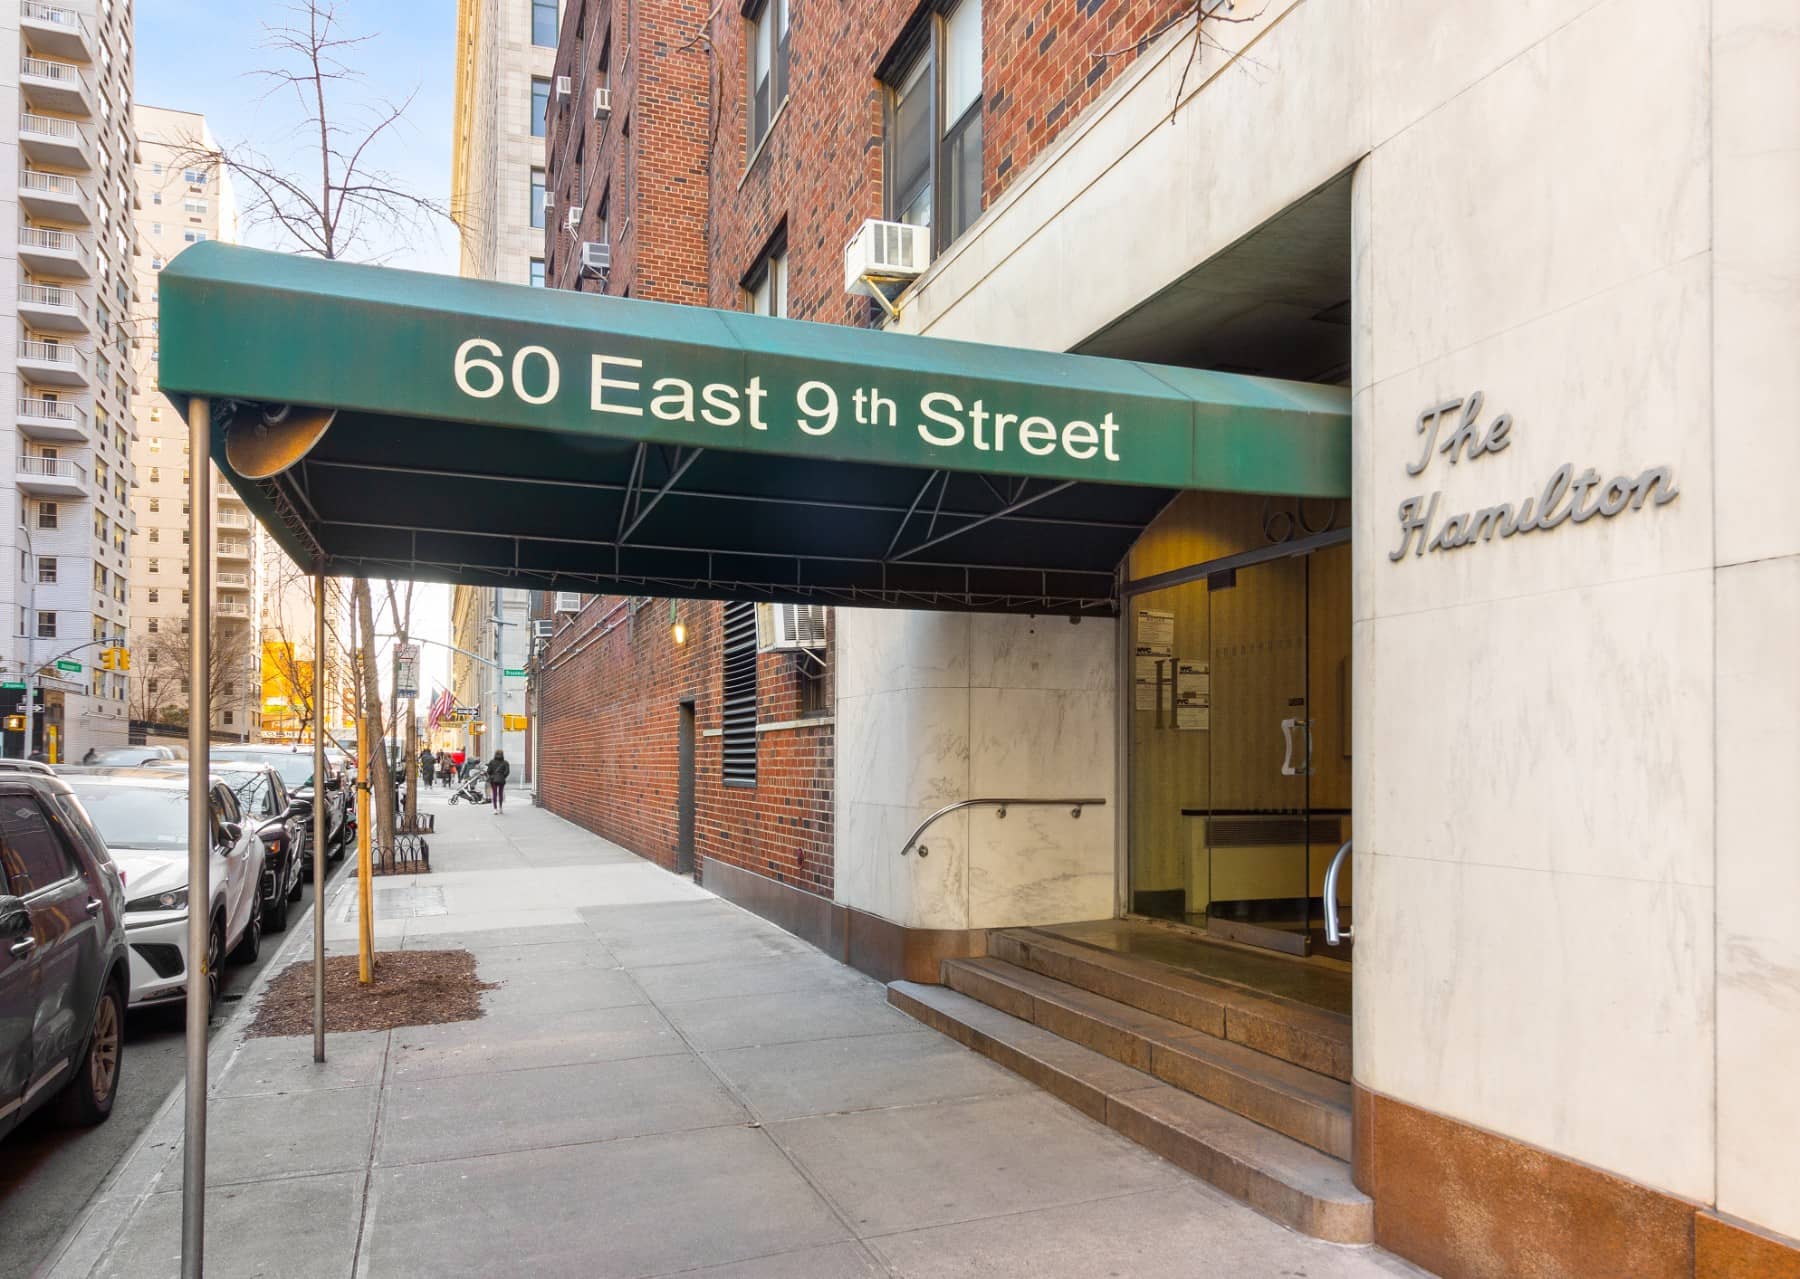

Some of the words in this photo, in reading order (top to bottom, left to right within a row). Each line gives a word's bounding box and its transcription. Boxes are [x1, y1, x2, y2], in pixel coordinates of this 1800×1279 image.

[454, 338, 560, 404] 60
[590, 354, 768, 430] East
[796, 380, 839, 436] 9
[852, 386, 897, 427] th
[917, 391, 1120, 462] Street
[1406, 390, 1514, 476] The
[1389, 462, 1680, 562] Hamilton
